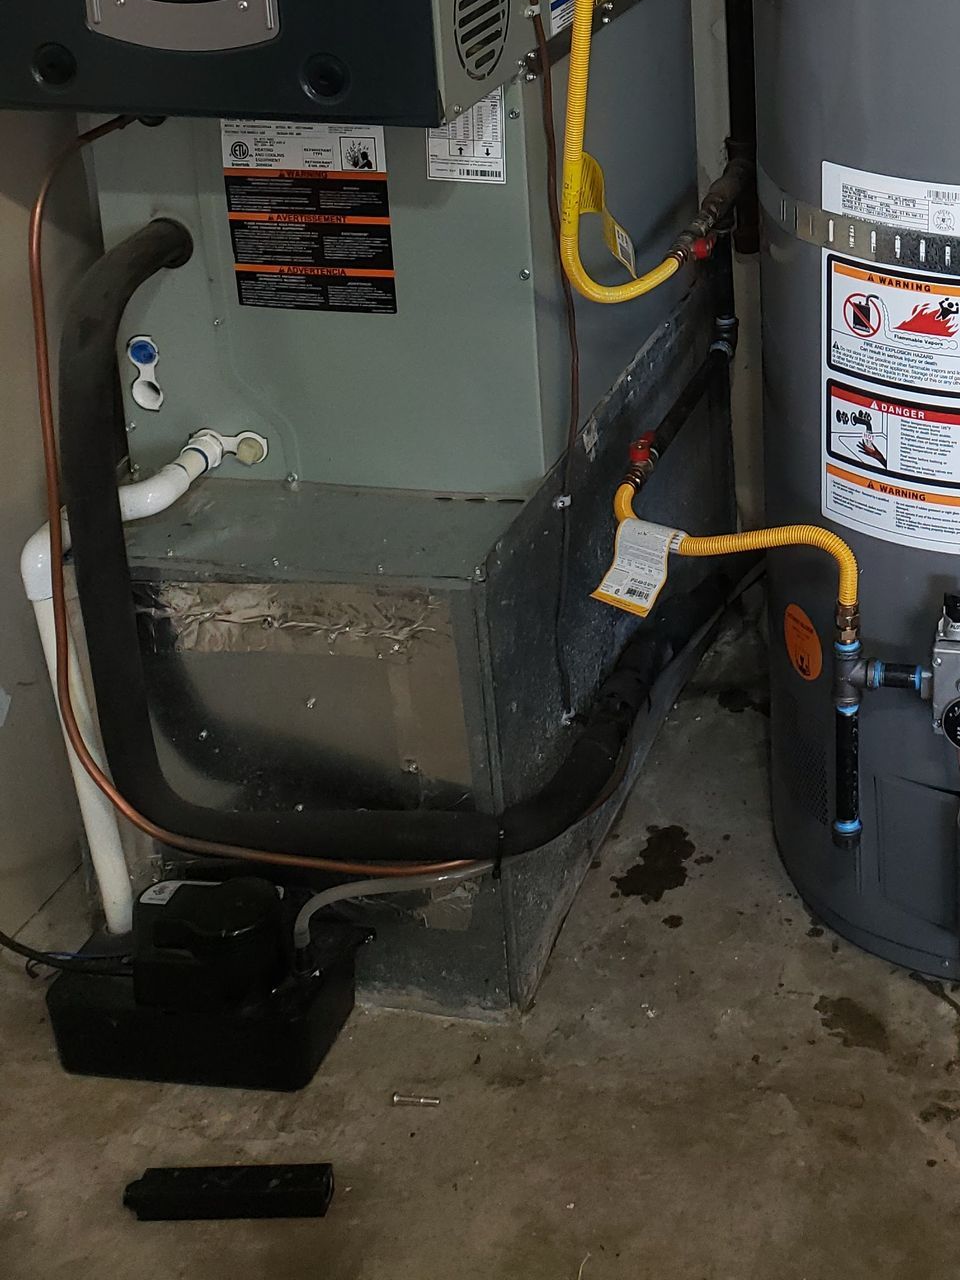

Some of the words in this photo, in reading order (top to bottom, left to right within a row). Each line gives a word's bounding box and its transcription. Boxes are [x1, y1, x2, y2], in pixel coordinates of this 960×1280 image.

[286, 170, 328, 178] WARNING
[277, 215, 347, 223] AVERTISSEMENT
[287, 267, 346, 275] ADVERTENCIA
[879, 276, 931, 293] WARNING
[894, 334, 923, 344] Flammable
[885, 345, 912, 357] EXPLOSION
[913, 352, 933, 360] HAZARD
[882, 404, 925, 420] DANGER
[880, 484, 926, 501] WARNING
